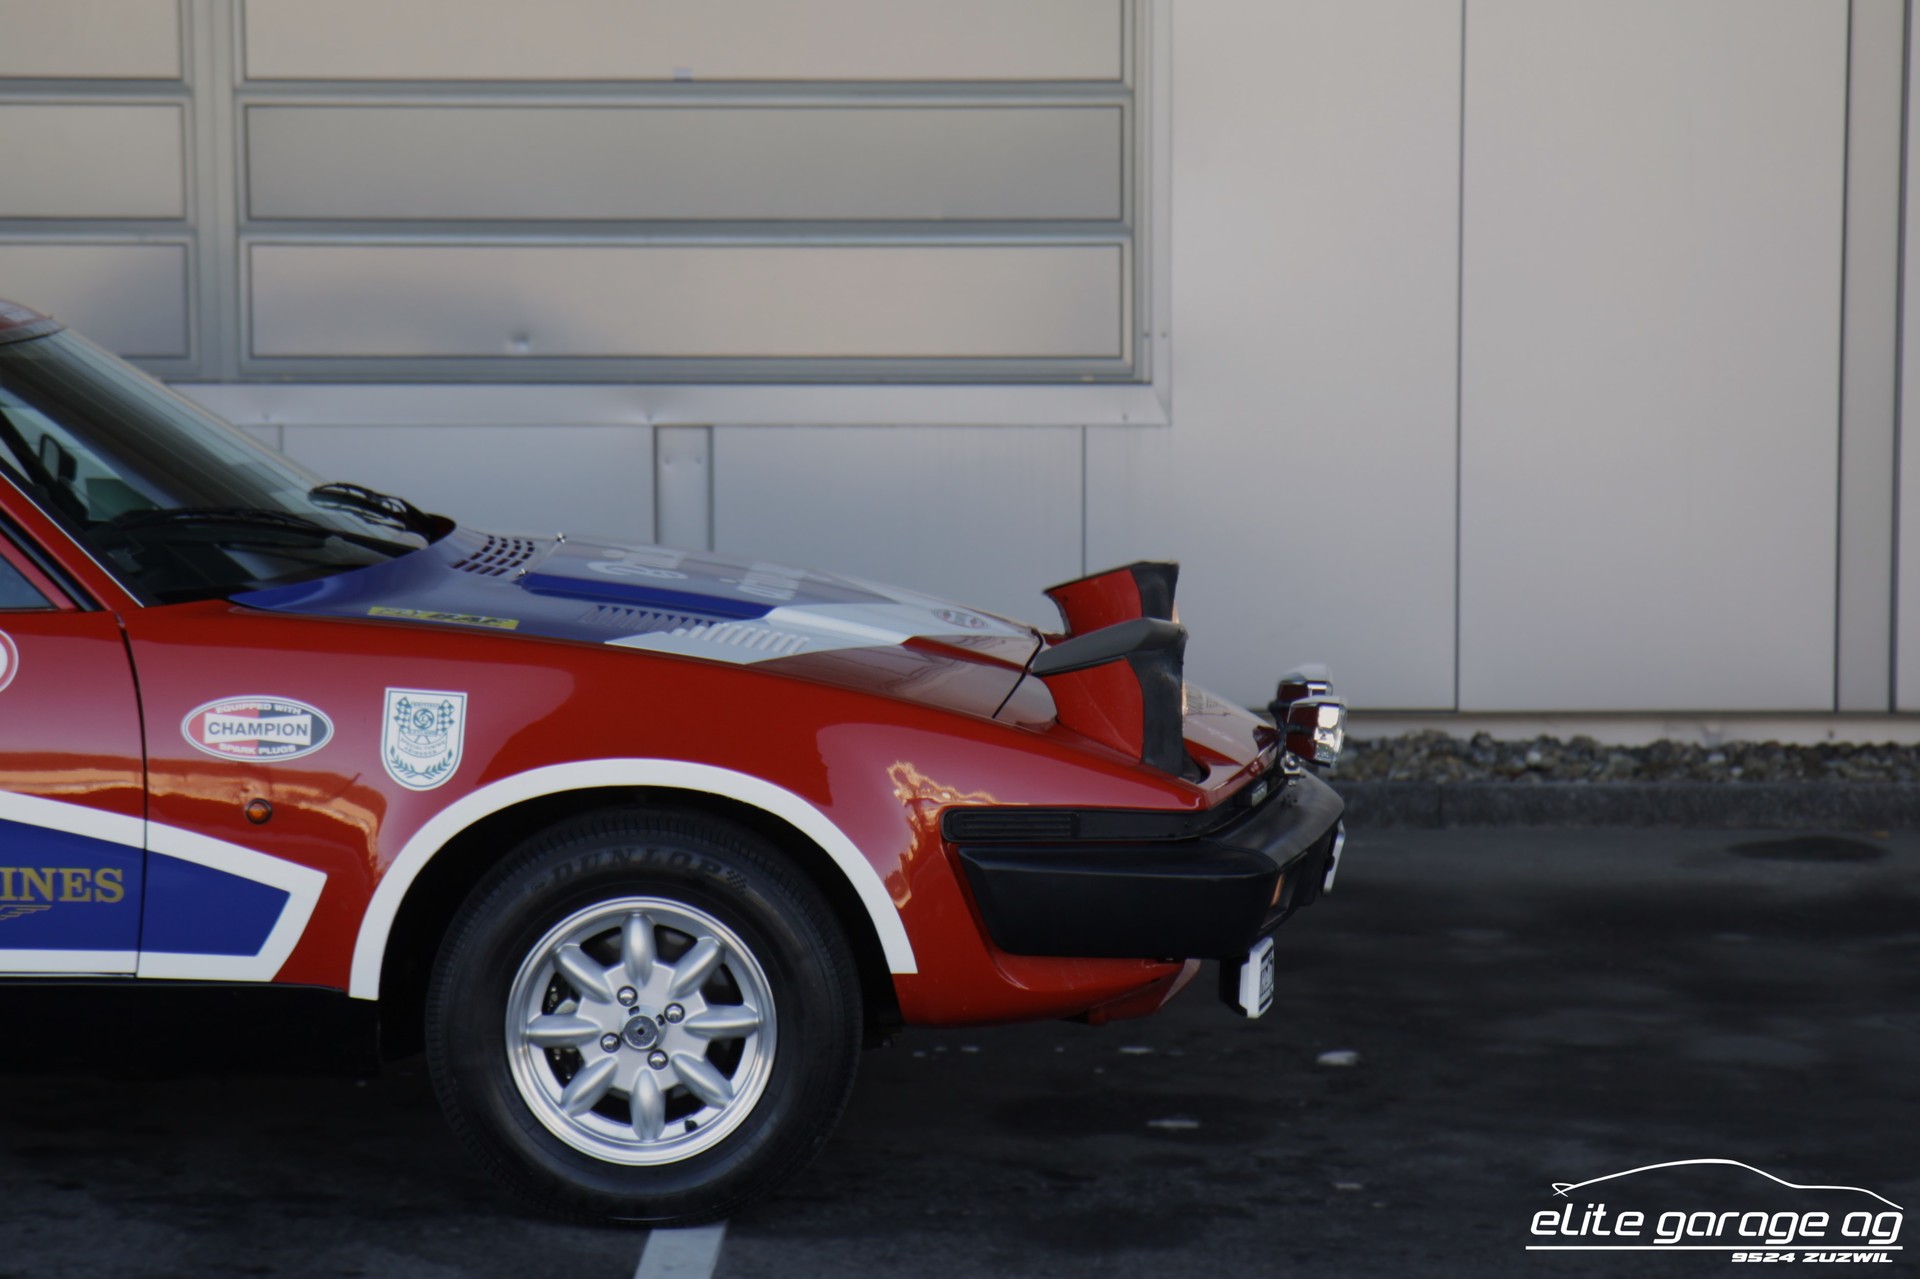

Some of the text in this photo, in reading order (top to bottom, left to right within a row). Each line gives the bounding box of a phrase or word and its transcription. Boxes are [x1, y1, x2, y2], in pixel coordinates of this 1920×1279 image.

[215, 703, 302, 715] EQUIPPED WITH
[207, 721, 309, 737] CHAMPION
[219, 743, 298, 755] SPARK PLUGS
[551, 847, 722, 886] DUNLOP
